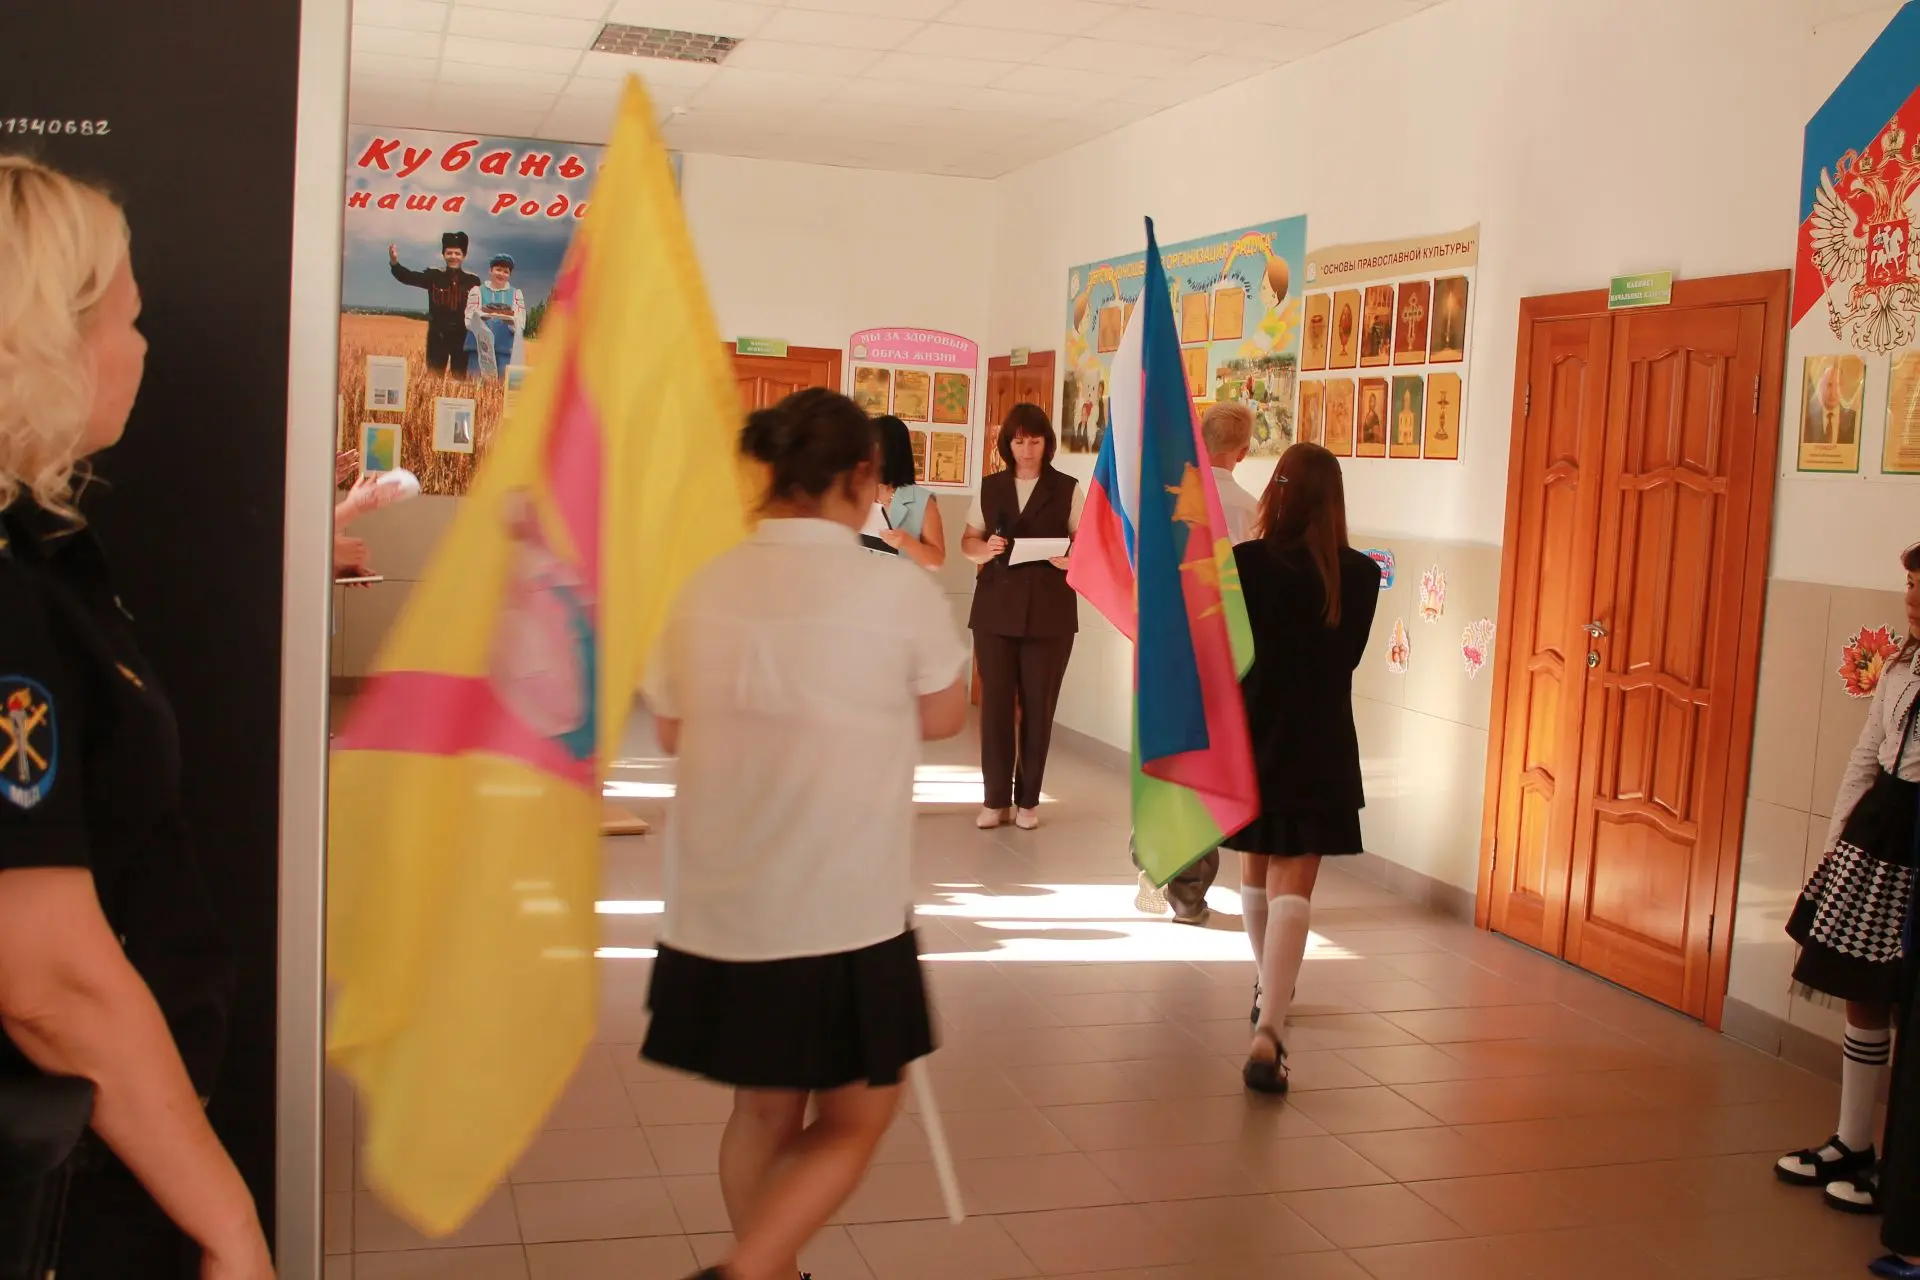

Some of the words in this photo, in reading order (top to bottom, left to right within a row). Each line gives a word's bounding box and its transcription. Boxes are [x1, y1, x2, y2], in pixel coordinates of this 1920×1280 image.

[0, 117, 111, 135] 1340682
[358, 138, 585, 178] Кубань
[348, 191, 466, 213] наша
[1357, 250, 1421, 270] ПРАВОСЛАВНОЙ
[1422, 241, 1475, 259] КУЛЬТУРЫ"
[860, 333, 881, 344] МЫ
[884, 332, 900, 341] ЗА
[871, 348, 909, 360] ОБРАЗ
[913, 350, 957, 363] ЖИЗНИ
